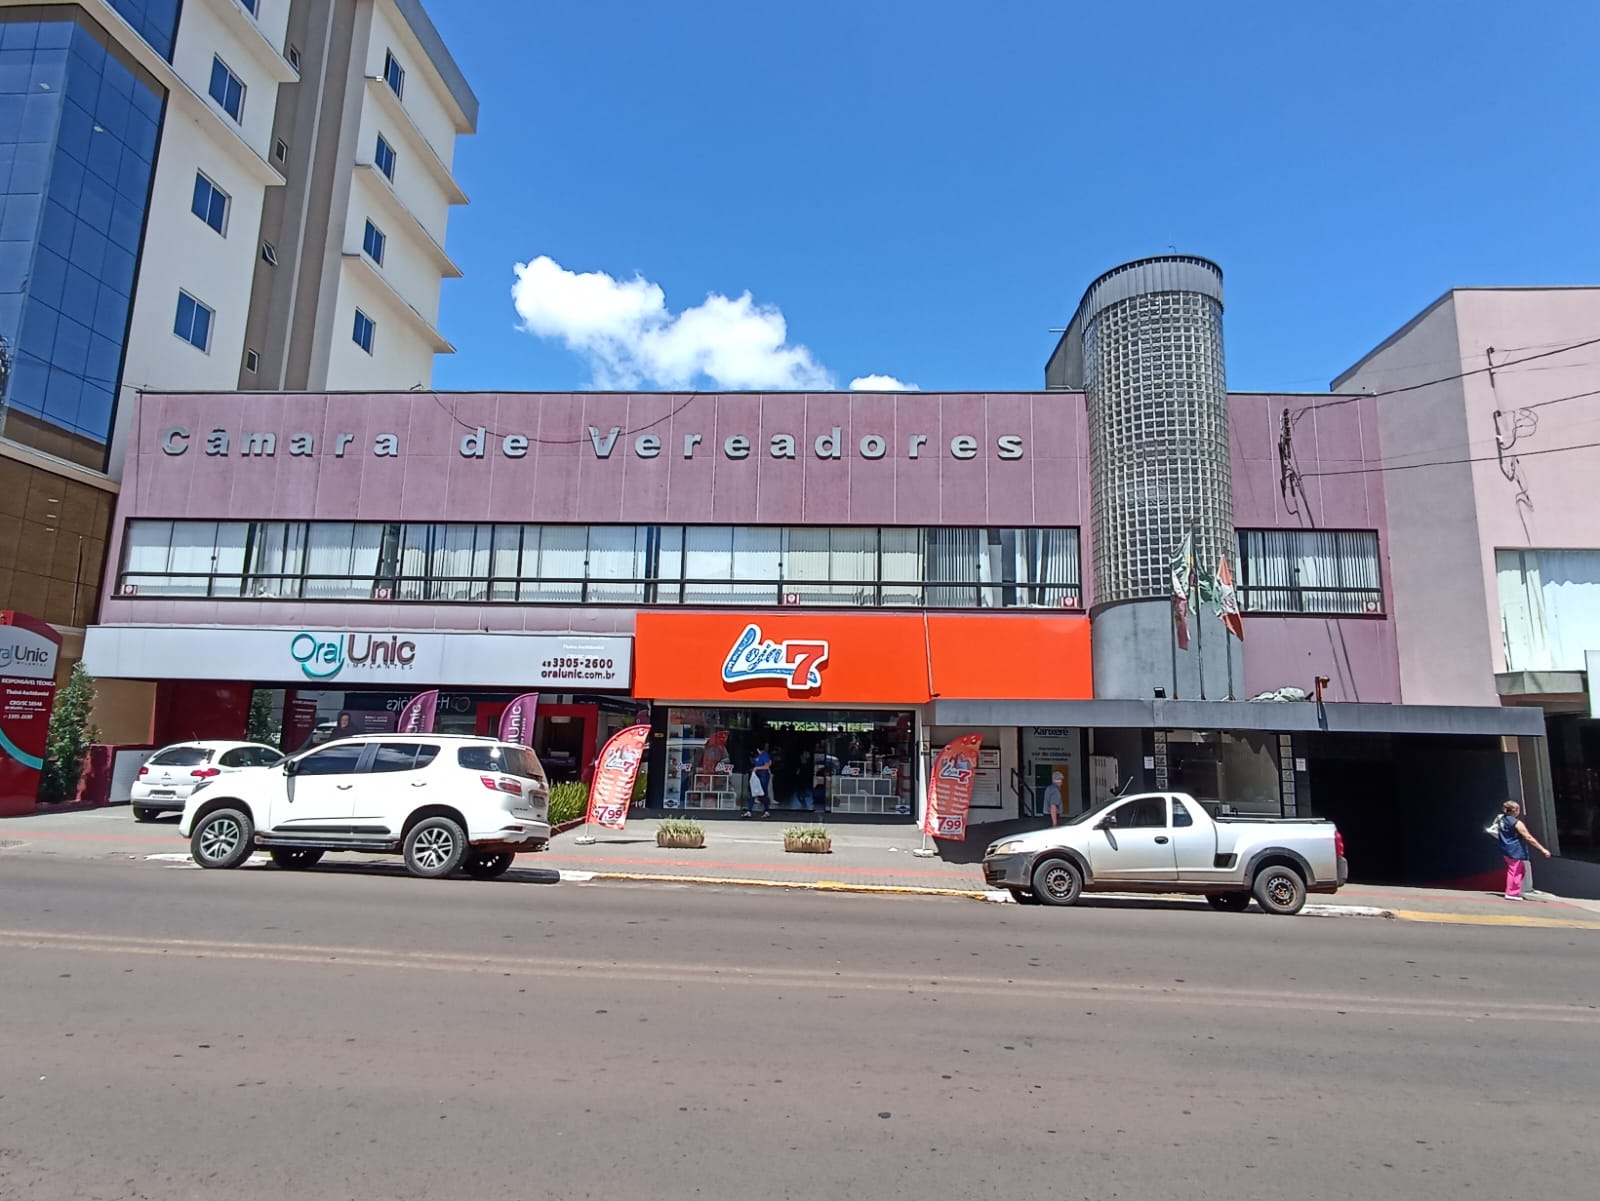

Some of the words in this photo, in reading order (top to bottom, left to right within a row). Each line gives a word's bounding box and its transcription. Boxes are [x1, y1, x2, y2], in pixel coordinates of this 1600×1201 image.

[161, 425, 400, 457] Câmara
[458, 427, 531, 458] de
[588, 425, 1024, 461] Vereadores
[15, 645, 48, 662] Unic
[290, 633, 345, 667] Oral
[348, 633, 417, 667] Unic
[541, 668, 616, 680] oralunic.com.br
[552, 658, 614, 669] 3305-2600
[786, 644, 825, 686] 7
